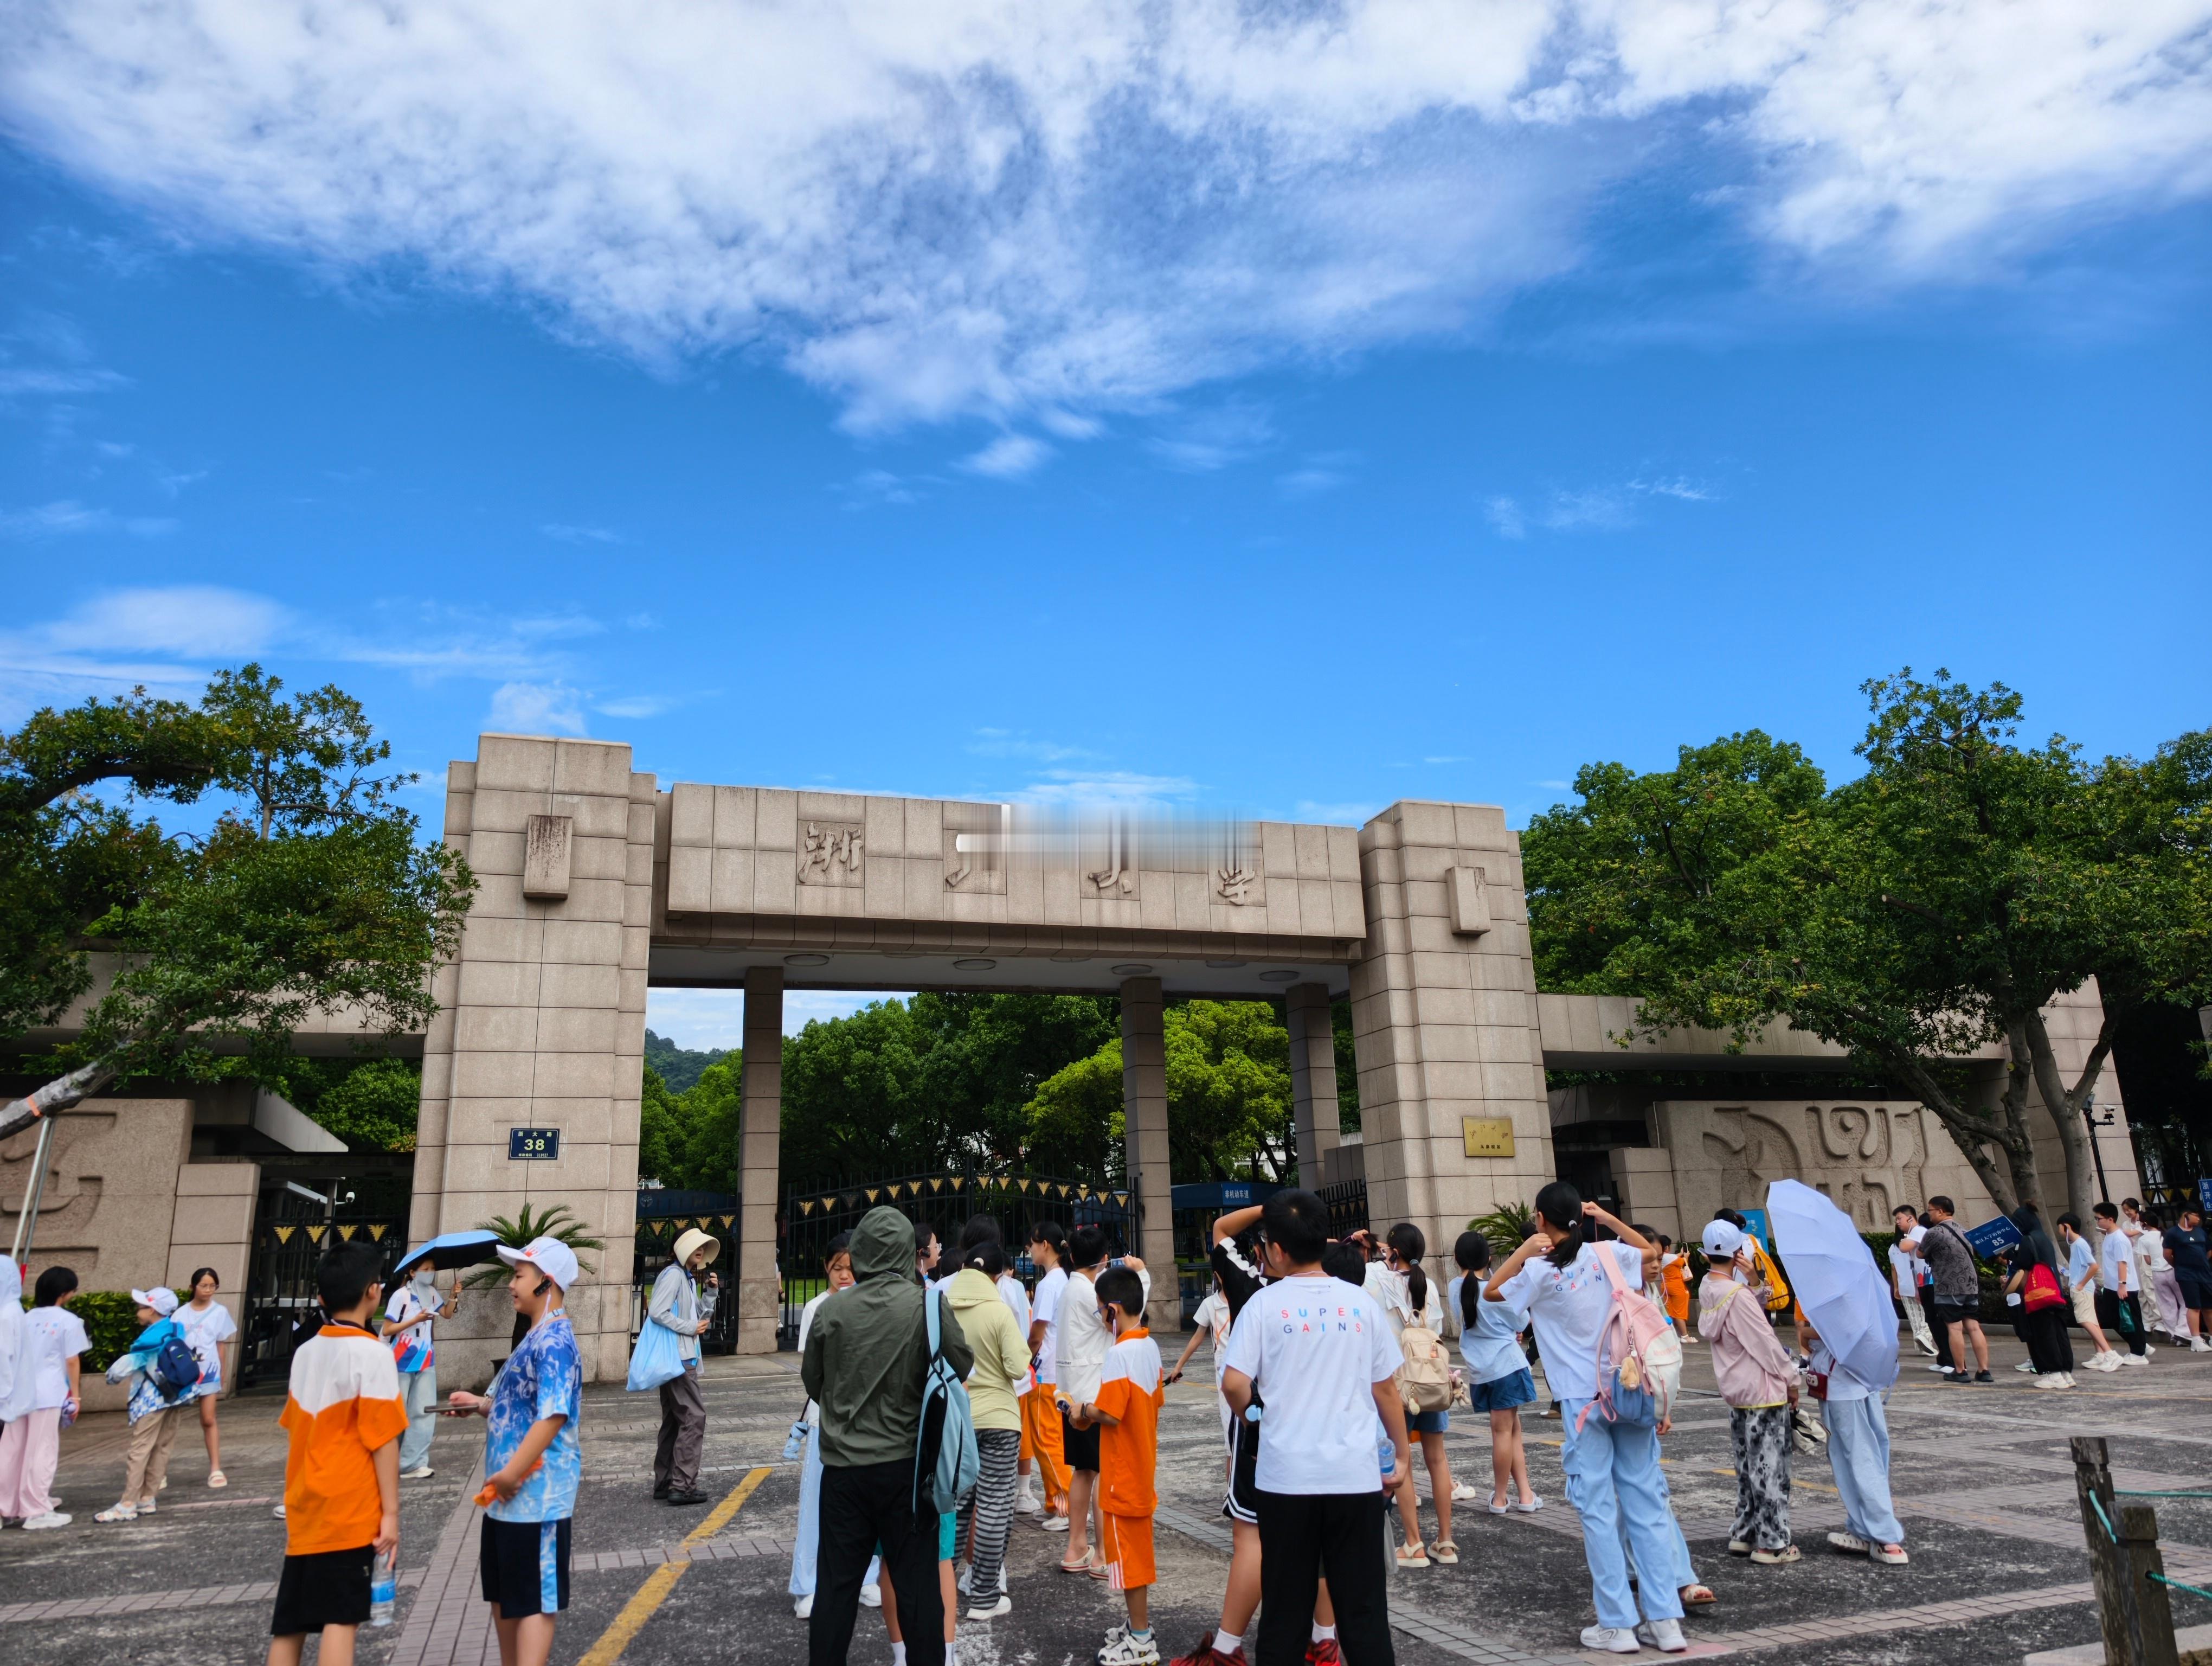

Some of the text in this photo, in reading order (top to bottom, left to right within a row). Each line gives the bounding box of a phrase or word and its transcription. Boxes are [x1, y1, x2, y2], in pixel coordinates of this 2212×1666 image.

[798, 822, 1255, 906] 浙学
[524, 1139, 545, 1151] 38
[1225, 1189, 1249, 1199] 非机动车道
[1991, 1237, 2004, 1246] 85
[1553, 1263, 1599, 1280] SUPE
[1555, 1274, 1602, 1292] GAIN
[1281, 1307, 1360, 1319] SUPER
[1283, 1322, 1361, 1334] GAINS
